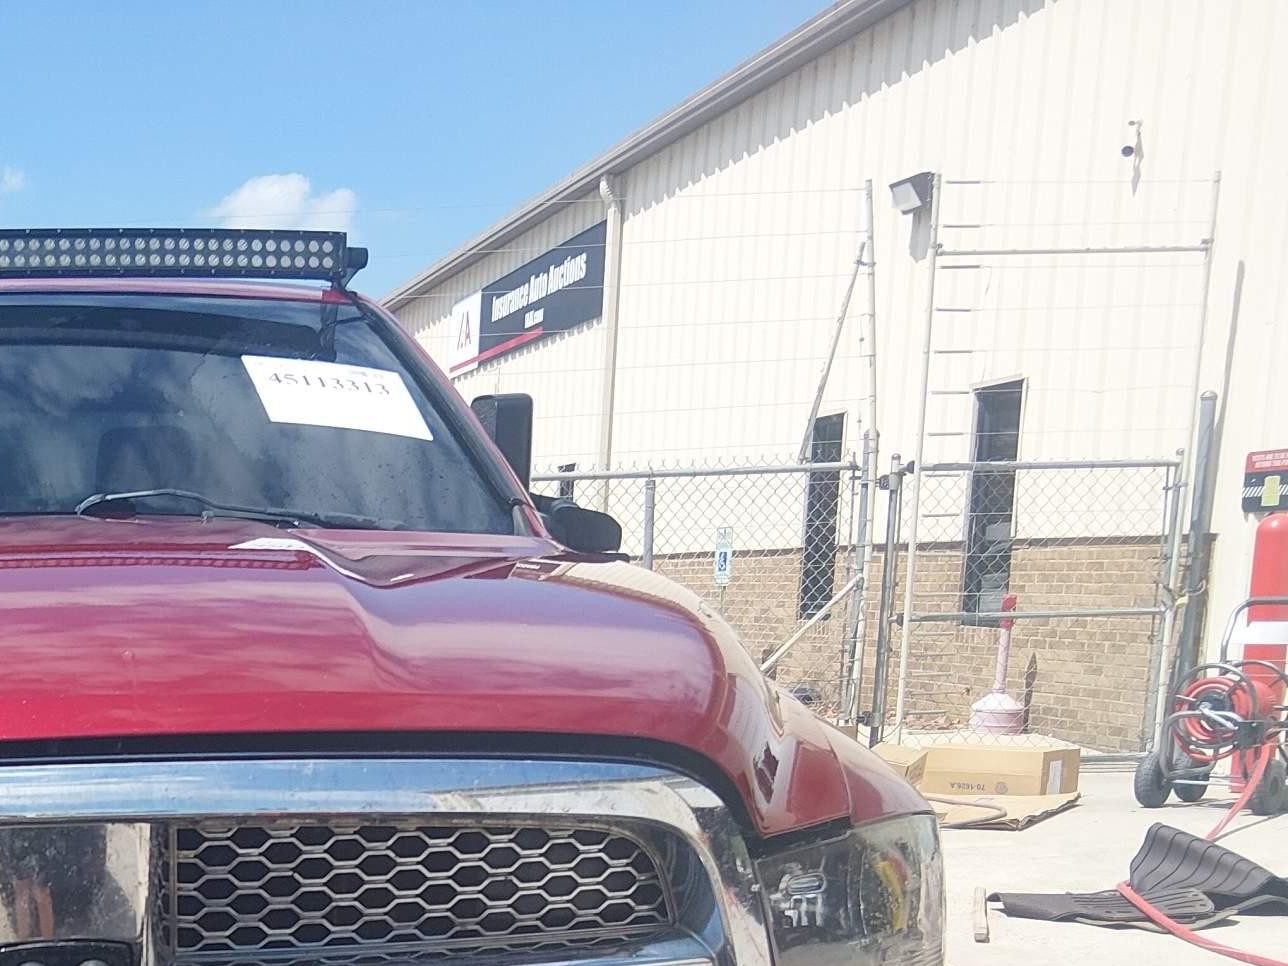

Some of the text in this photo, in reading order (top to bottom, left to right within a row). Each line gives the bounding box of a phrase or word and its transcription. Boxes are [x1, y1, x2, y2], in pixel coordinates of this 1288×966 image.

[491, 252, 587, 323] Insurance Auto Auctions
[268, 372, 390, 396] 45113313
